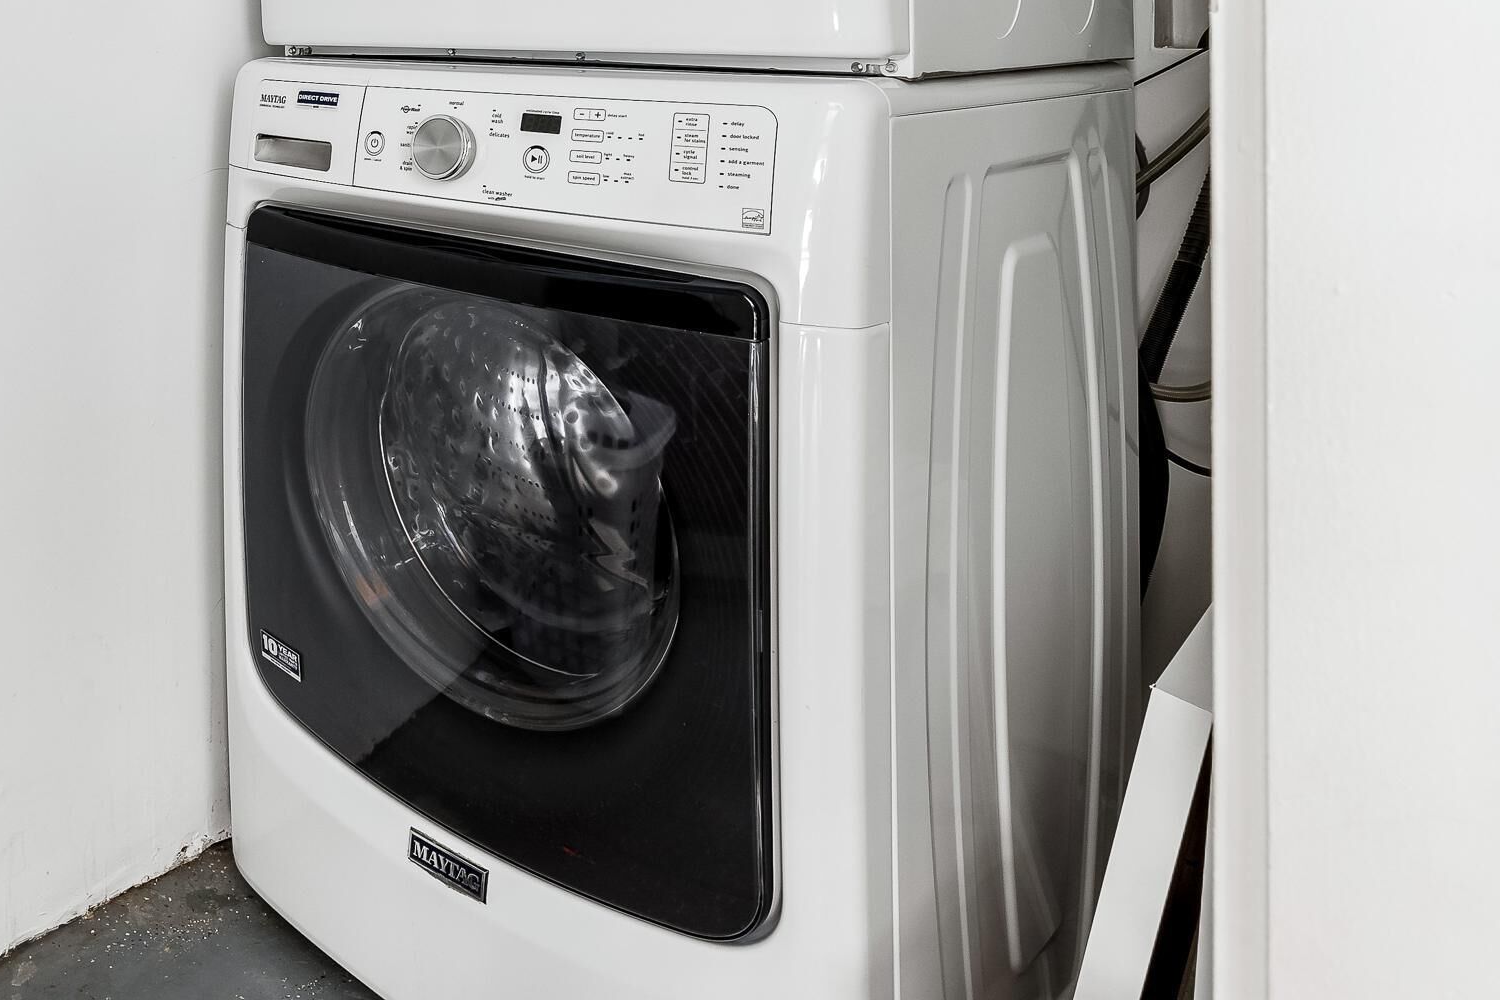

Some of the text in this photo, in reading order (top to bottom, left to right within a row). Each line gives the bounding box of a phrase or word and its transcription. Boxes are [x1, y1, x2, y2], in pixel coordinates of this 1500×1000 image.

[260, 94, 287, 104] MAYTAG
[320, 95, 338, 103] DRIVE
[263, 634, 277, 656] 10
[278, 644, 298, 662] YEAR
[413, 839, 480, 891] MAYTAG
